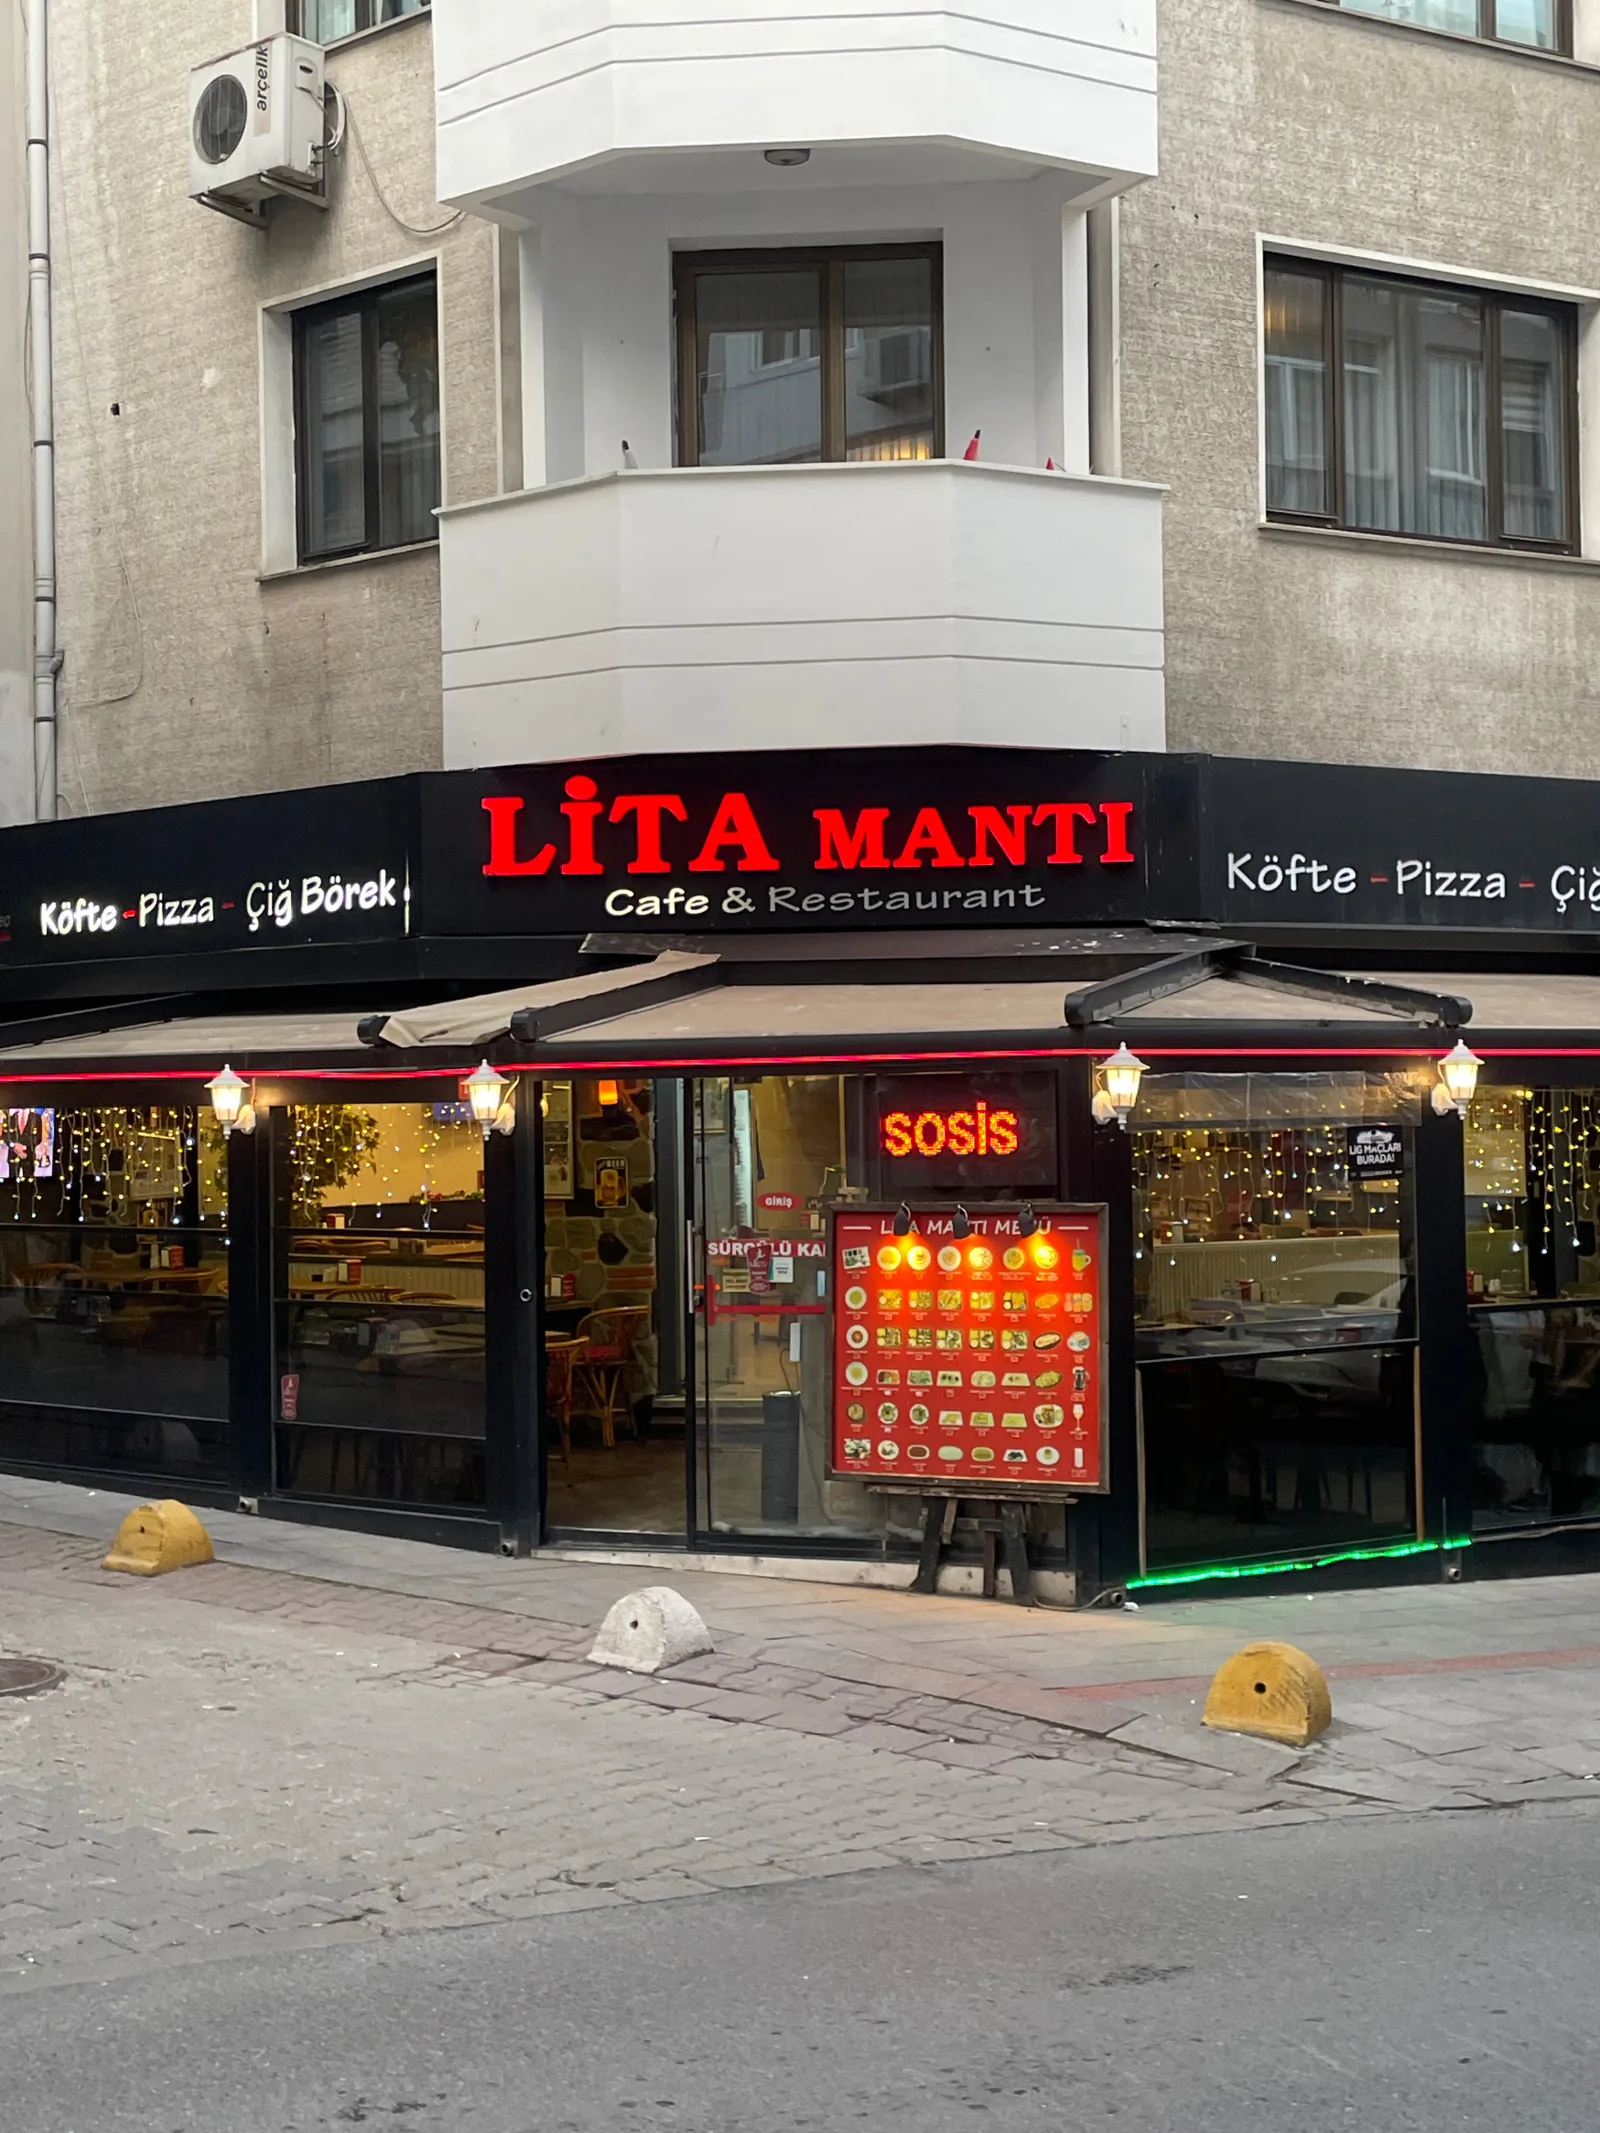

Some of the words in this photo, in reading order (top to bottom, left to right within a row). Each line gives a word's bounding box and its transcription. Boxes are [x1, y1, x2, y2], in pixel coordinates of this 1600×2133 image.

[256, 46, 270, 111] arçelik
[481, 775, 780, 876] LİTA
[812, 801, 1135, 870] MANTI
[1227, 852, 1357, 894] Köfte
[1396, 859, 1506, 899] Pizza
[40, 897, 119, 936] Köfte
[138, 892, 214, 928] Pizza
[246, 878, 294, 932] Çiğ
[300, 868, 397, 915] Börek
[605, 887, 710, 916] Cafe
[721, 886, 756, 914] &
[768, 884, 1046, 912] Restaurant
[927, 1219, 987, 1235] MATI
[994, 1216, 1052, 1235] MEÜ
[797, 1243, 826, 1257] KA
